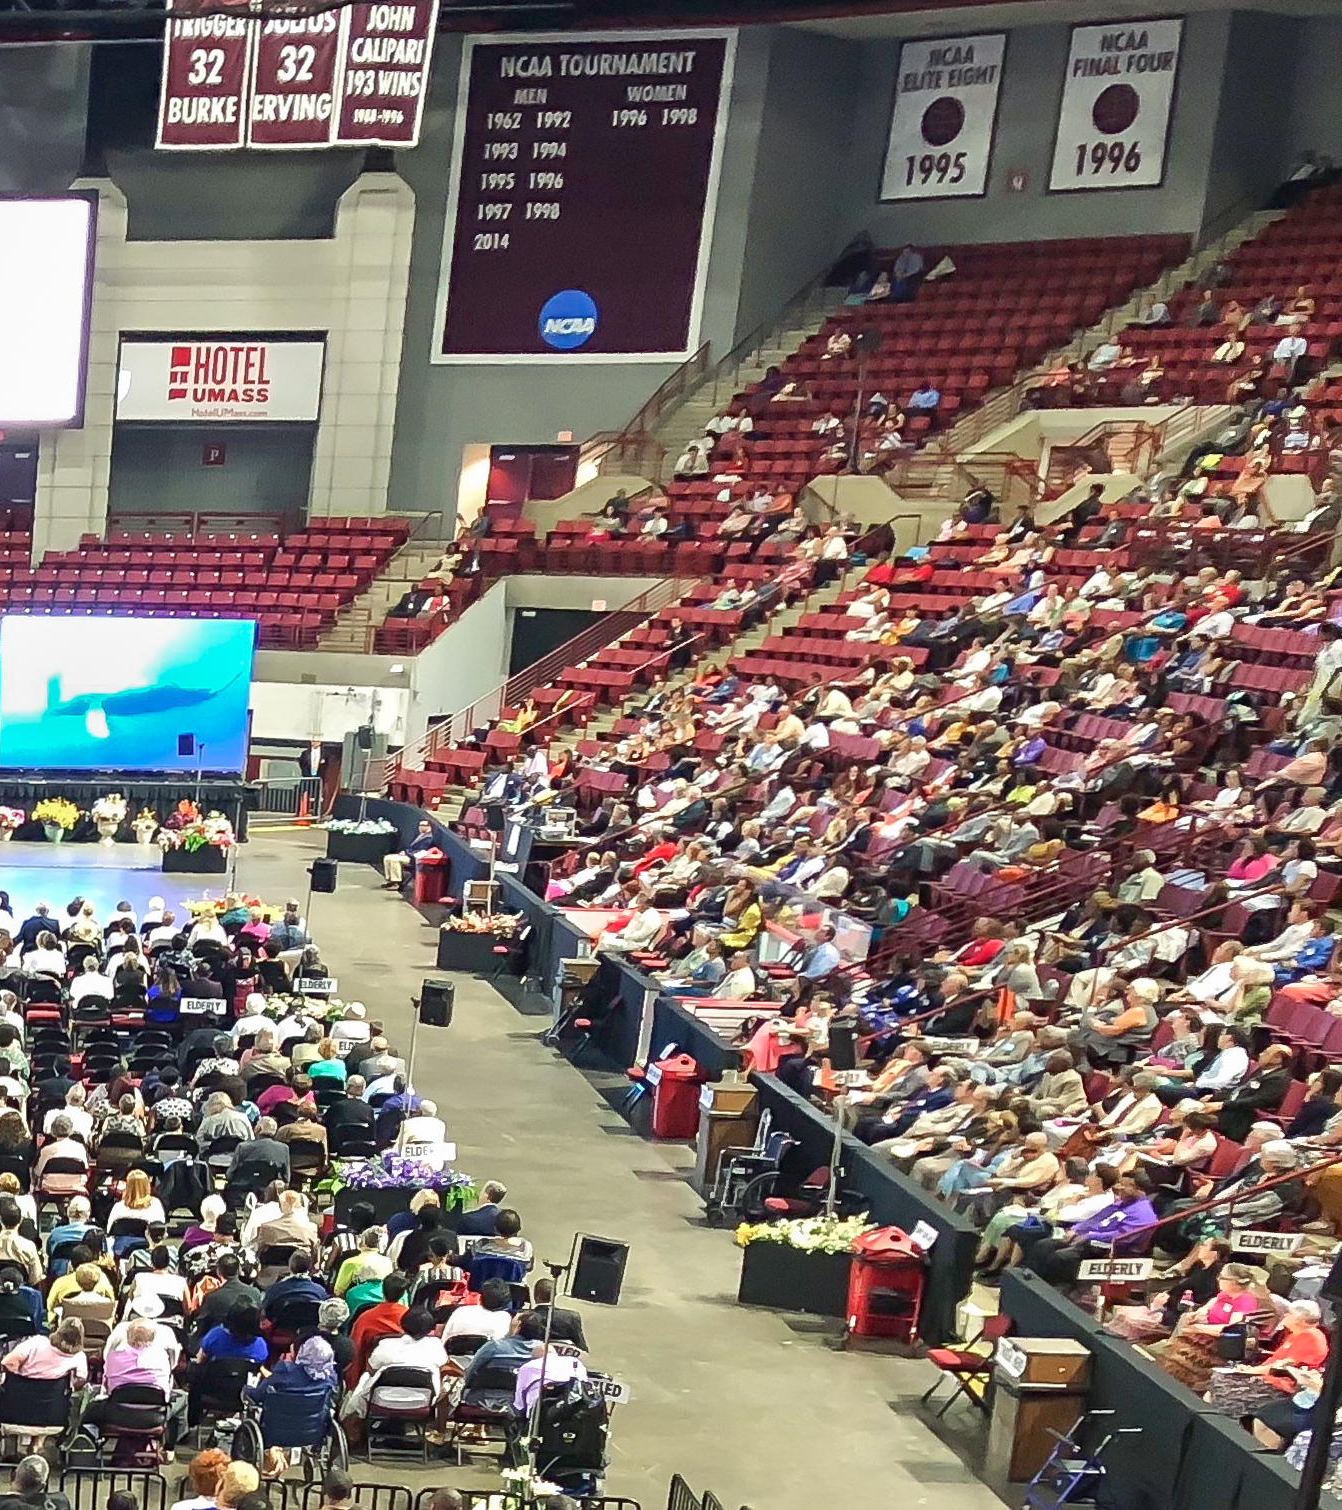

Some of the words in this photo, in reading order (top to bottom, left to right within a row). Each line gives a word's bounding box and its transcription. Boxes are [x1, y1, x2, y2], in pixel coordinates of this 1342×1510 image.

[367, 6, 415, 31] JOHN
[352, 38, 426, 64] CALIPARI
[1101, 31, 1149, 52] NCAA
[277, 45, 316, 82] 32
[501, 55, 553, 77] NCAA
[560, 52, 696, 77] TOURNAMENT
[928, 45, 974, 67] NCAA
[1073, 57, 1122, 78] FINAL
[1126, 51, 1174, 74] FOUR
[188, 49, 225, 85] 32
[347, 70, 374, 96] 193
[378, 70, 422, 97] WINS
[901, 72, 942, 93] ELITE
[947, 65, 998, 86] EIGHT
[514, 88, 548, 104] MEN
[627, 84, 688, 102] WOMEN
[168, 97, 238, 124] BURKE
[253, 93, 333, 121] ERVING
[487, 112, 522, 130] 1962
[536, 111, 572, 129] 1992
[612, 110, 648, 127] 1996
[662, 109, 698, 126] 1998
[484, 142, 519, 160] 1993
[532, 142, 567, 159] 1994
[1075, 141, 1141, 176] 1996
[906, 152, 967, 186] 1995
[481, 173, 516, 191] 1995
[529, 173, 564, 190] 1996
[477, 203, 512, 221] 1997
[525, 202, 560, 220] 1998
[474, 233, 509, 251] 2014
[543, 317, 595, 335] NCAA
[193, 346, 271, 385] HOTEL
[192, 388, 269, 403] UMASS
[210, 449, 219, 461] P
[187, 1000, 221, 1011] ELDERLY
[1239, 1234, 1294, 1250] ELDERLY
[1088, 1262, 1144, 1276] ELDERLY
